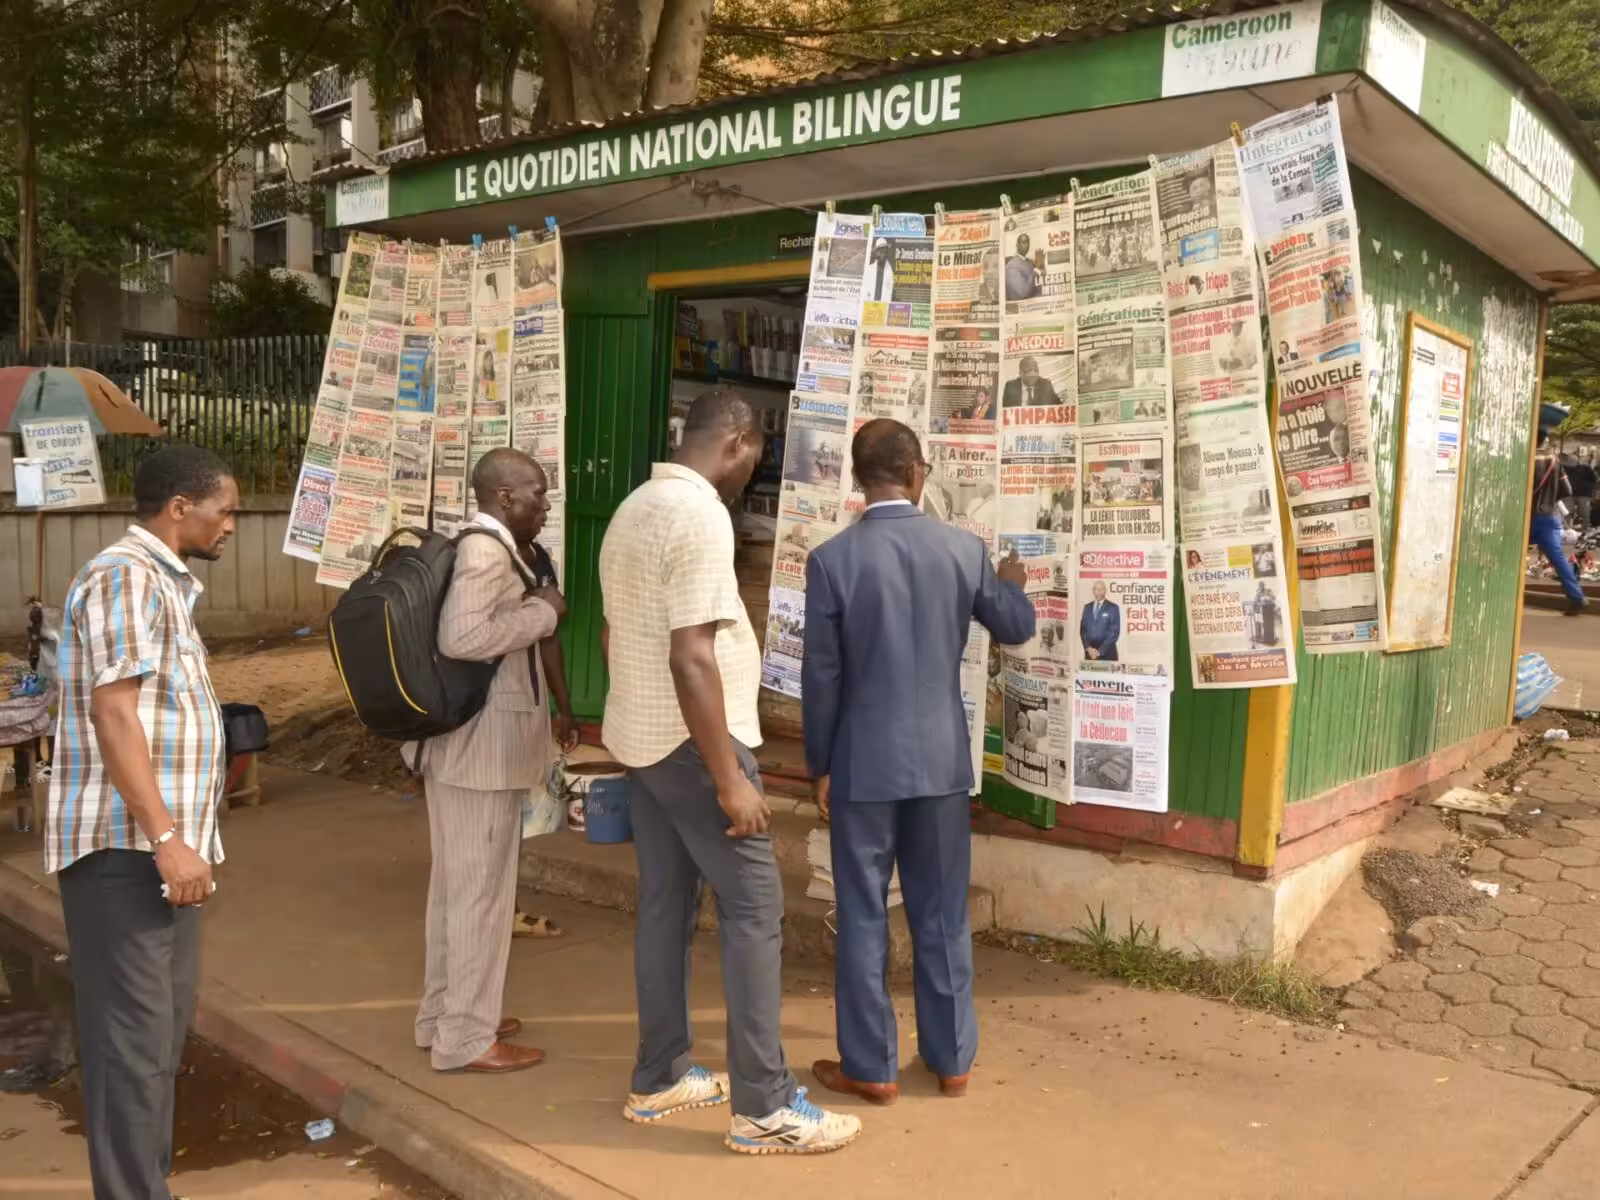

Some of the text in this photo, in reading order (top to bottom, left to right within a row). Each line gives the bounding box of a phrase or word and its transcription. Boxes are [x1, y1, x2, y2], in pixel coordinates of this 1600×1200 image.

[1171, 8, 1293, 49] Cameroon
[455, 75, 962, 202] LE QUOTIDIEN NATIONAL BILINGUE
[340, 176, 385, 197] Cameroon
[1271, 177, 1280, 187] de
[1280, 173, 1288, 183] la
[938, 252, 951, 266] Le
[1077, 306, 1150, 326] Génération
[1286, 361, 1362, 396] NOUVELLE
[1003, 406, 1076, 427] L'IMPASSE
[1117, 509, 1150, 522] TOUJOURS
[1109, 582, 1165, 594] Confiance
[1122, 594, 1165, 605] EBUNE
[1127, 607, 1165, 620] fait le
[1127, 620, 1165, 634] point
[1075, 679, 1134, 693] Nouvelle
